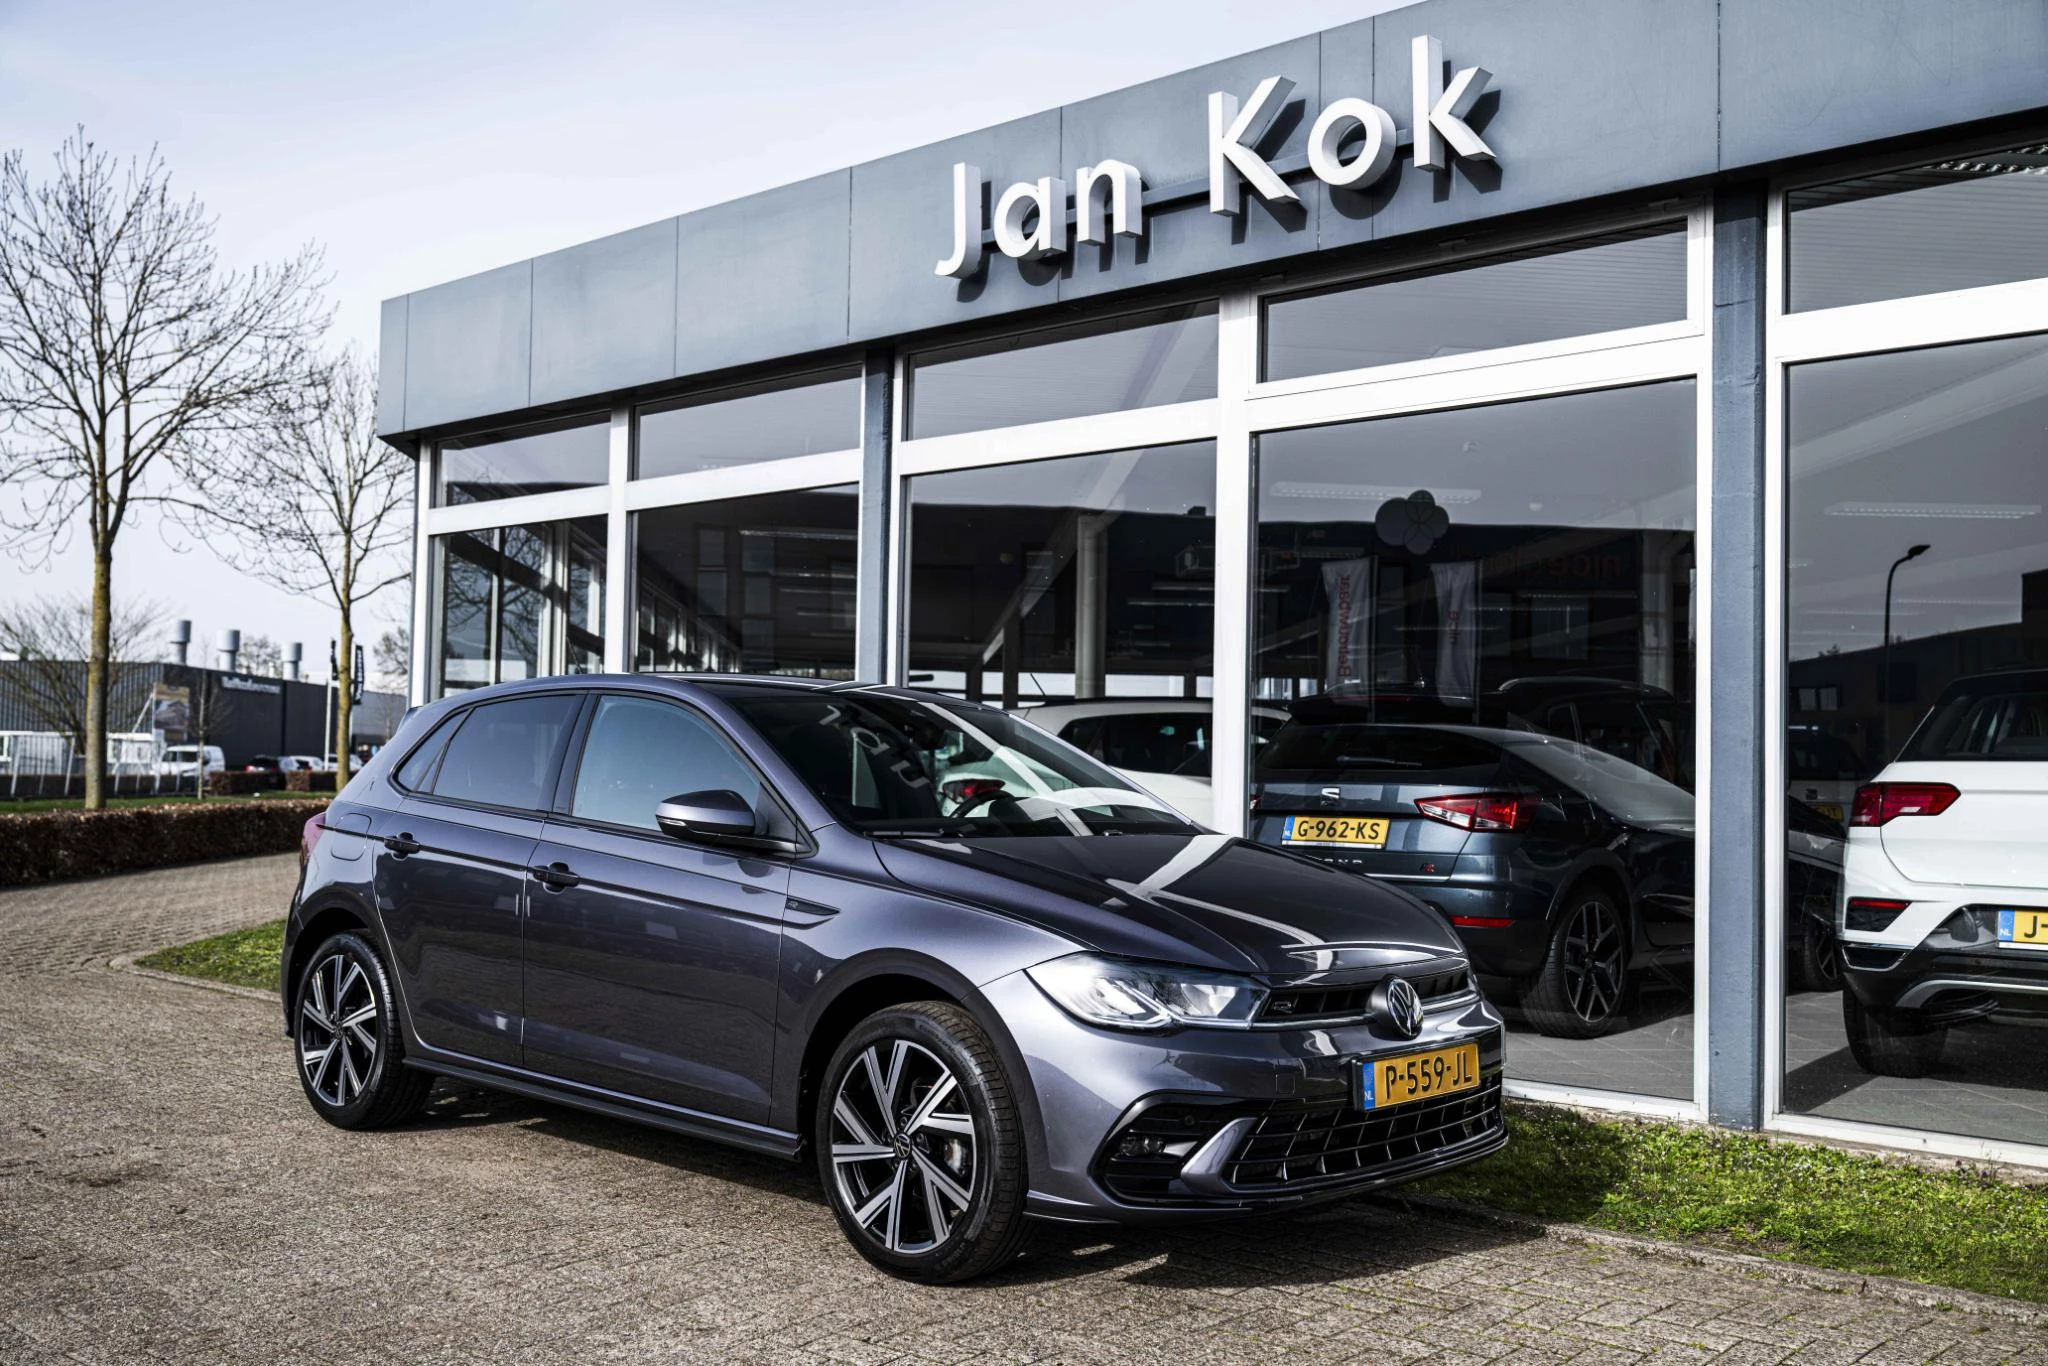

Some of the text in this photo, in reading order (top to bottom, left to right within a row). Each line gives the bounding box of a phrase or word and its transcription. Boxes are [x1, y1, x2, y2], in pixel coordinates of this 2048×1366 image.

[934, 34, 1497, 281] Jan Kok
[1297, 820, 1380, 840] G-962-KS
[1999, 927, 2012, 937] NL
[1364, 1051, 1473, 1101] NL P-559-JL
